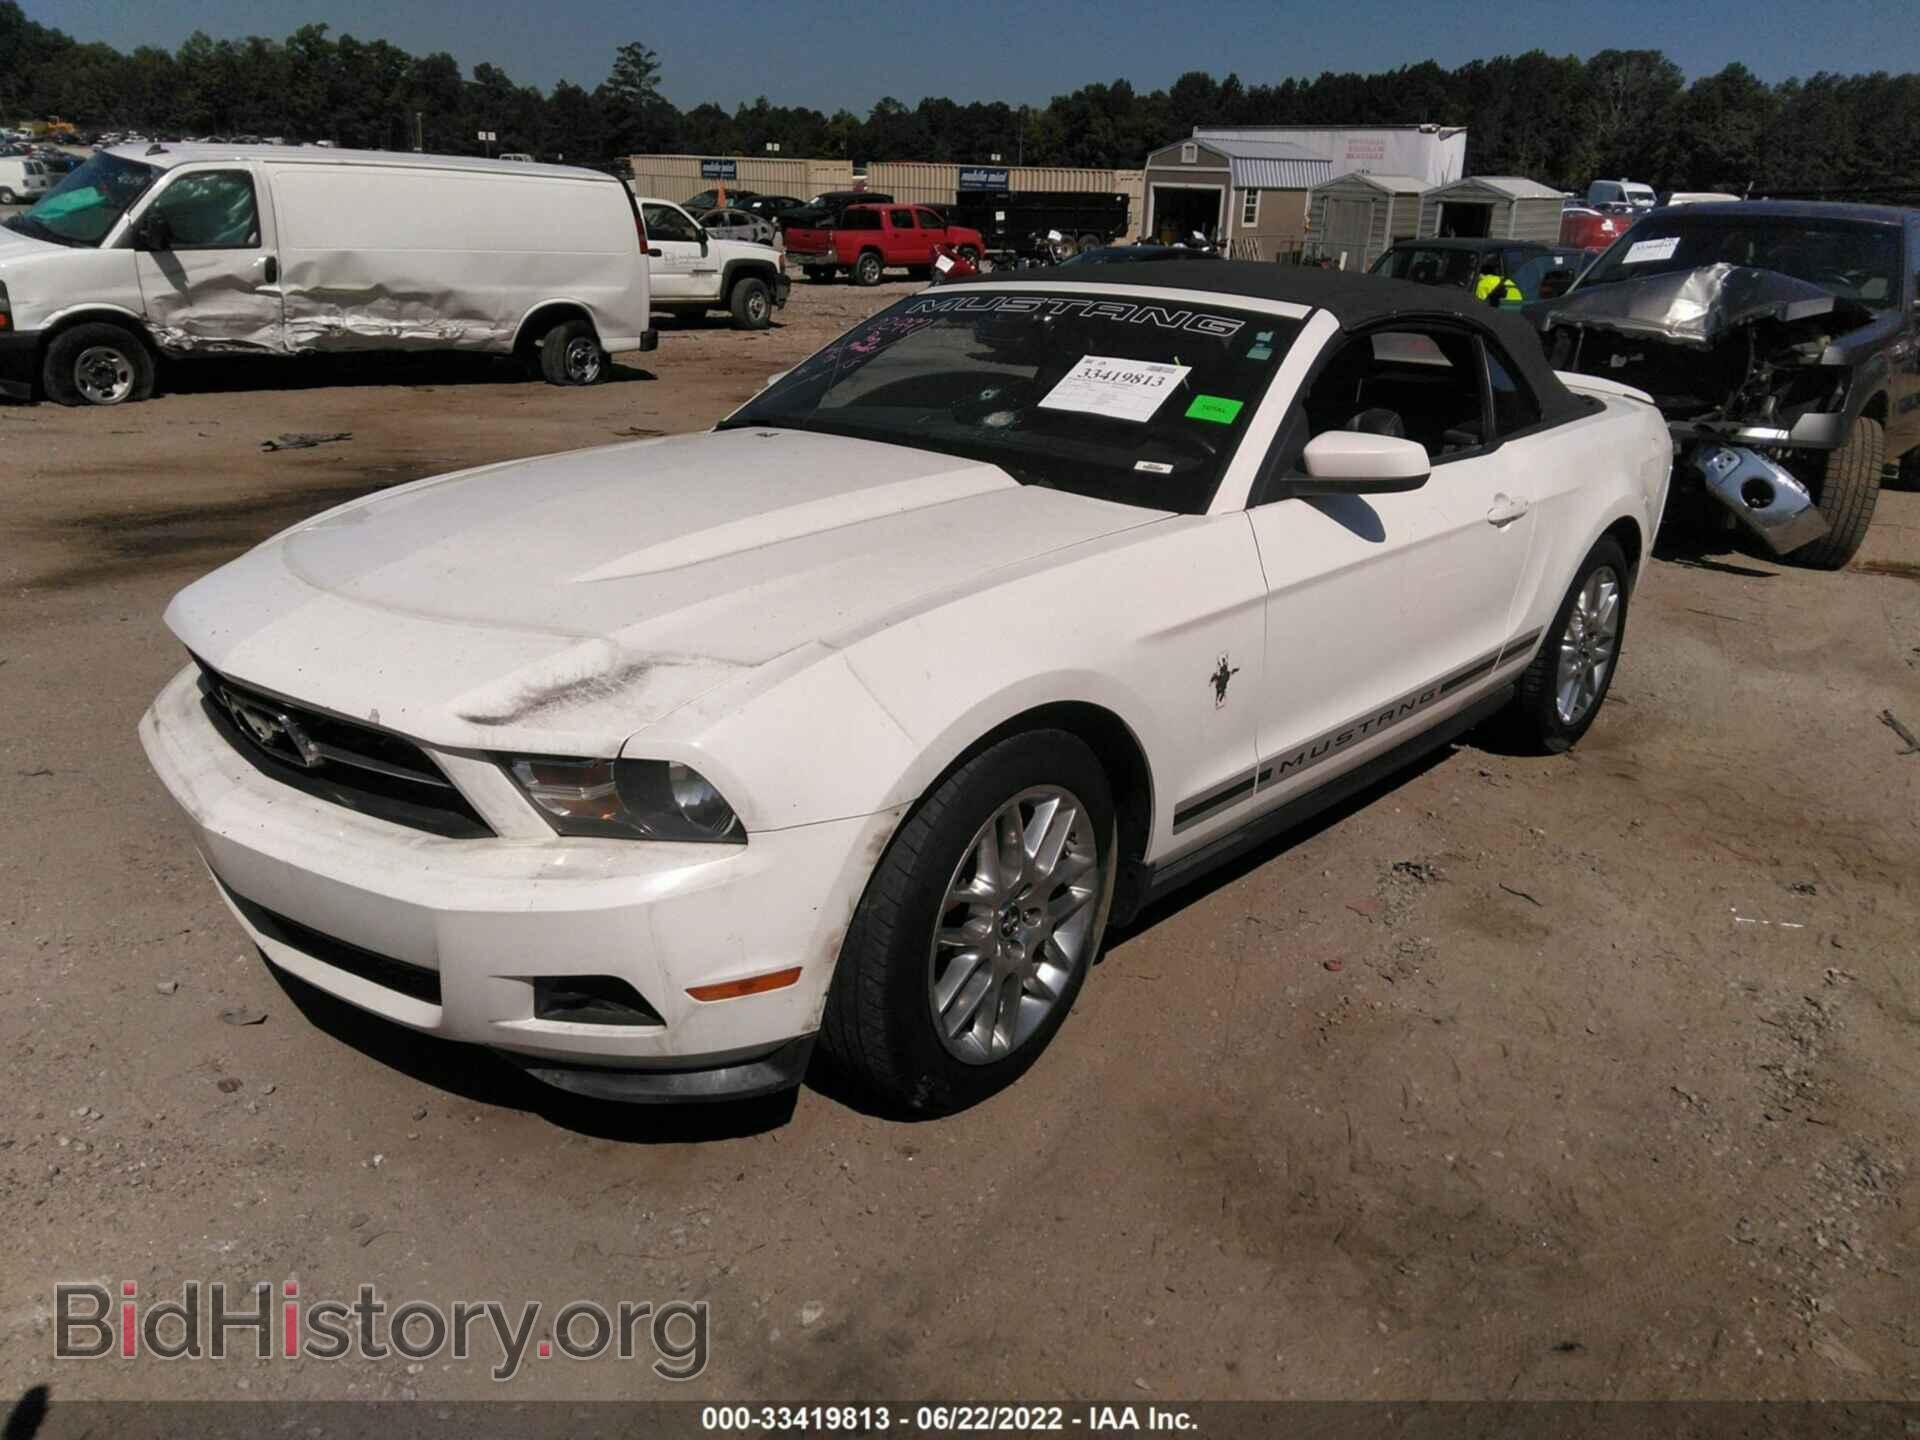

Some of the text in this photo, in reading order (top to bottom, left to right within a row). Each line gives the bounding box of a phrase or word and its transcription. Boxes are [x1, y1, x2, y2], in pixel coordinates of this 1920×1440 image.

[906, 297, 1245, 337] MUSTANG
[1077, 367, 1166, 388] 33419813
[1279, 688, 1437, 774] MUSTANG
